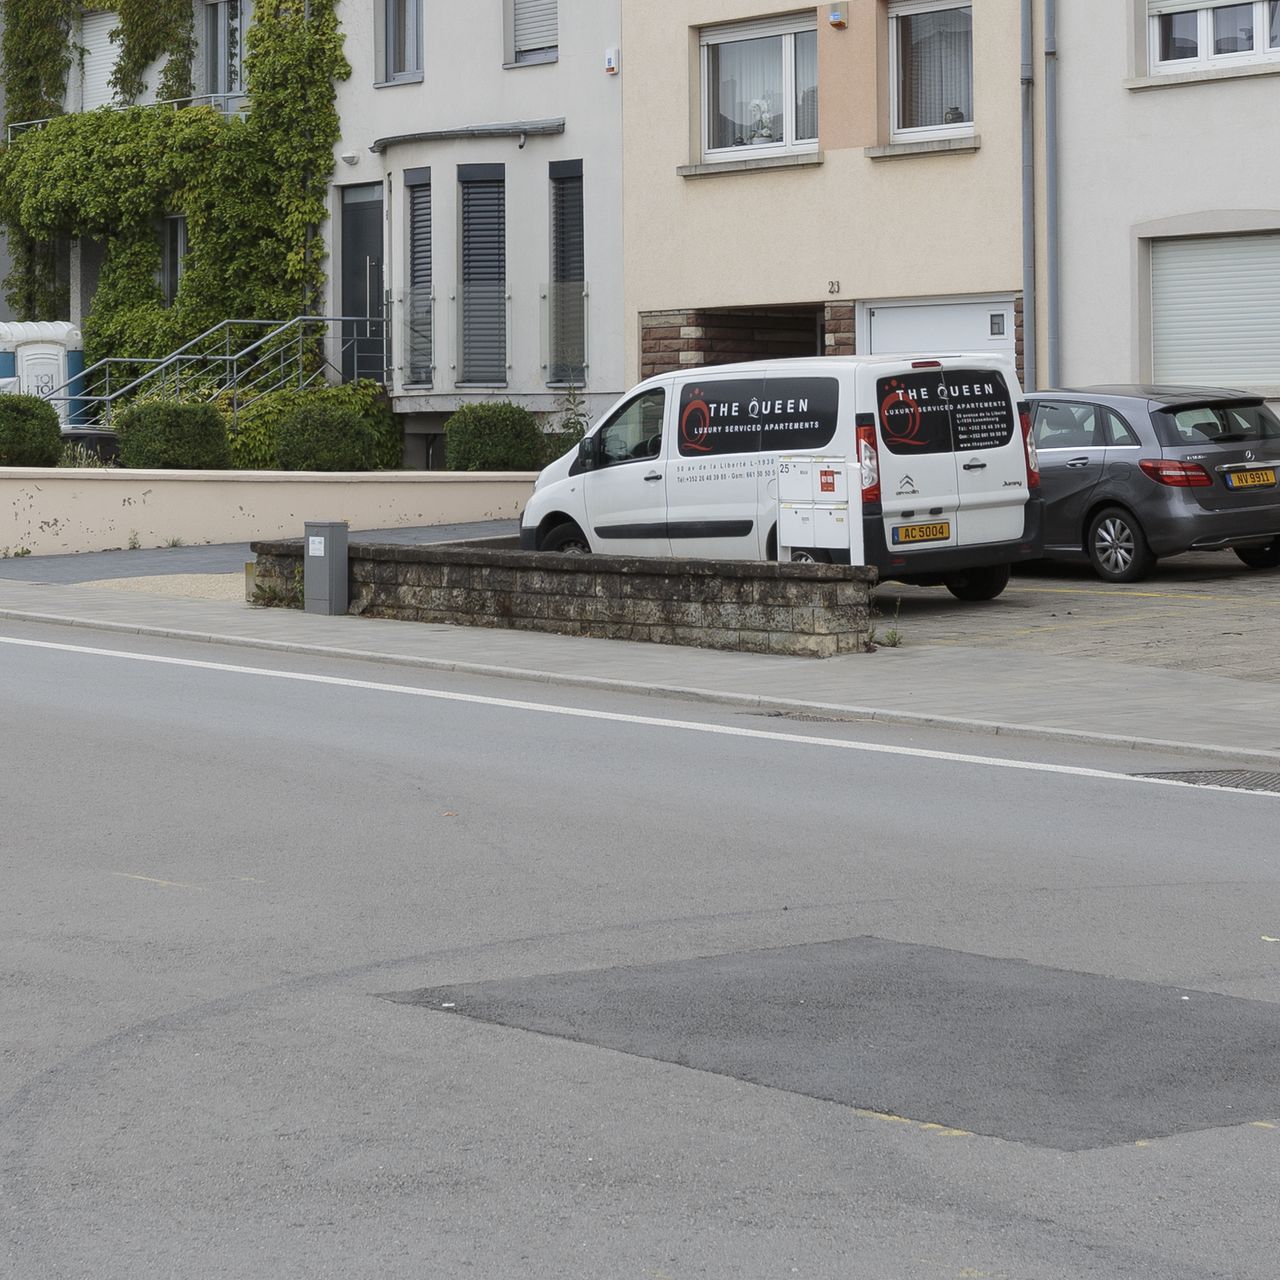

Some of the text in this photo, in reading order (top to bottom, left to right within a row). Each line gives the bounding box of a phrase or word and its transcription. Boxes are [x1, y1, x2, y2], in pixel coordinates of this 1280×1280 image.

[828, 280, 840, 294] 23
[34, 374, 53, 385] TOI
[896, 383, 994, 401] THE QUEEN
[709, 397, 809, 419] THE QUEEN
[884, 401, 1007, 416] LUXURY SERVICED APARTEMENTS
[694, 421, 820, 434] LUXURY SERVICED APARTEMENTS
[779, 463, 790, 474] 25
[1237, 472, 1270, 485] NV 9911
[904, 525, 944, 540] AC 5004
